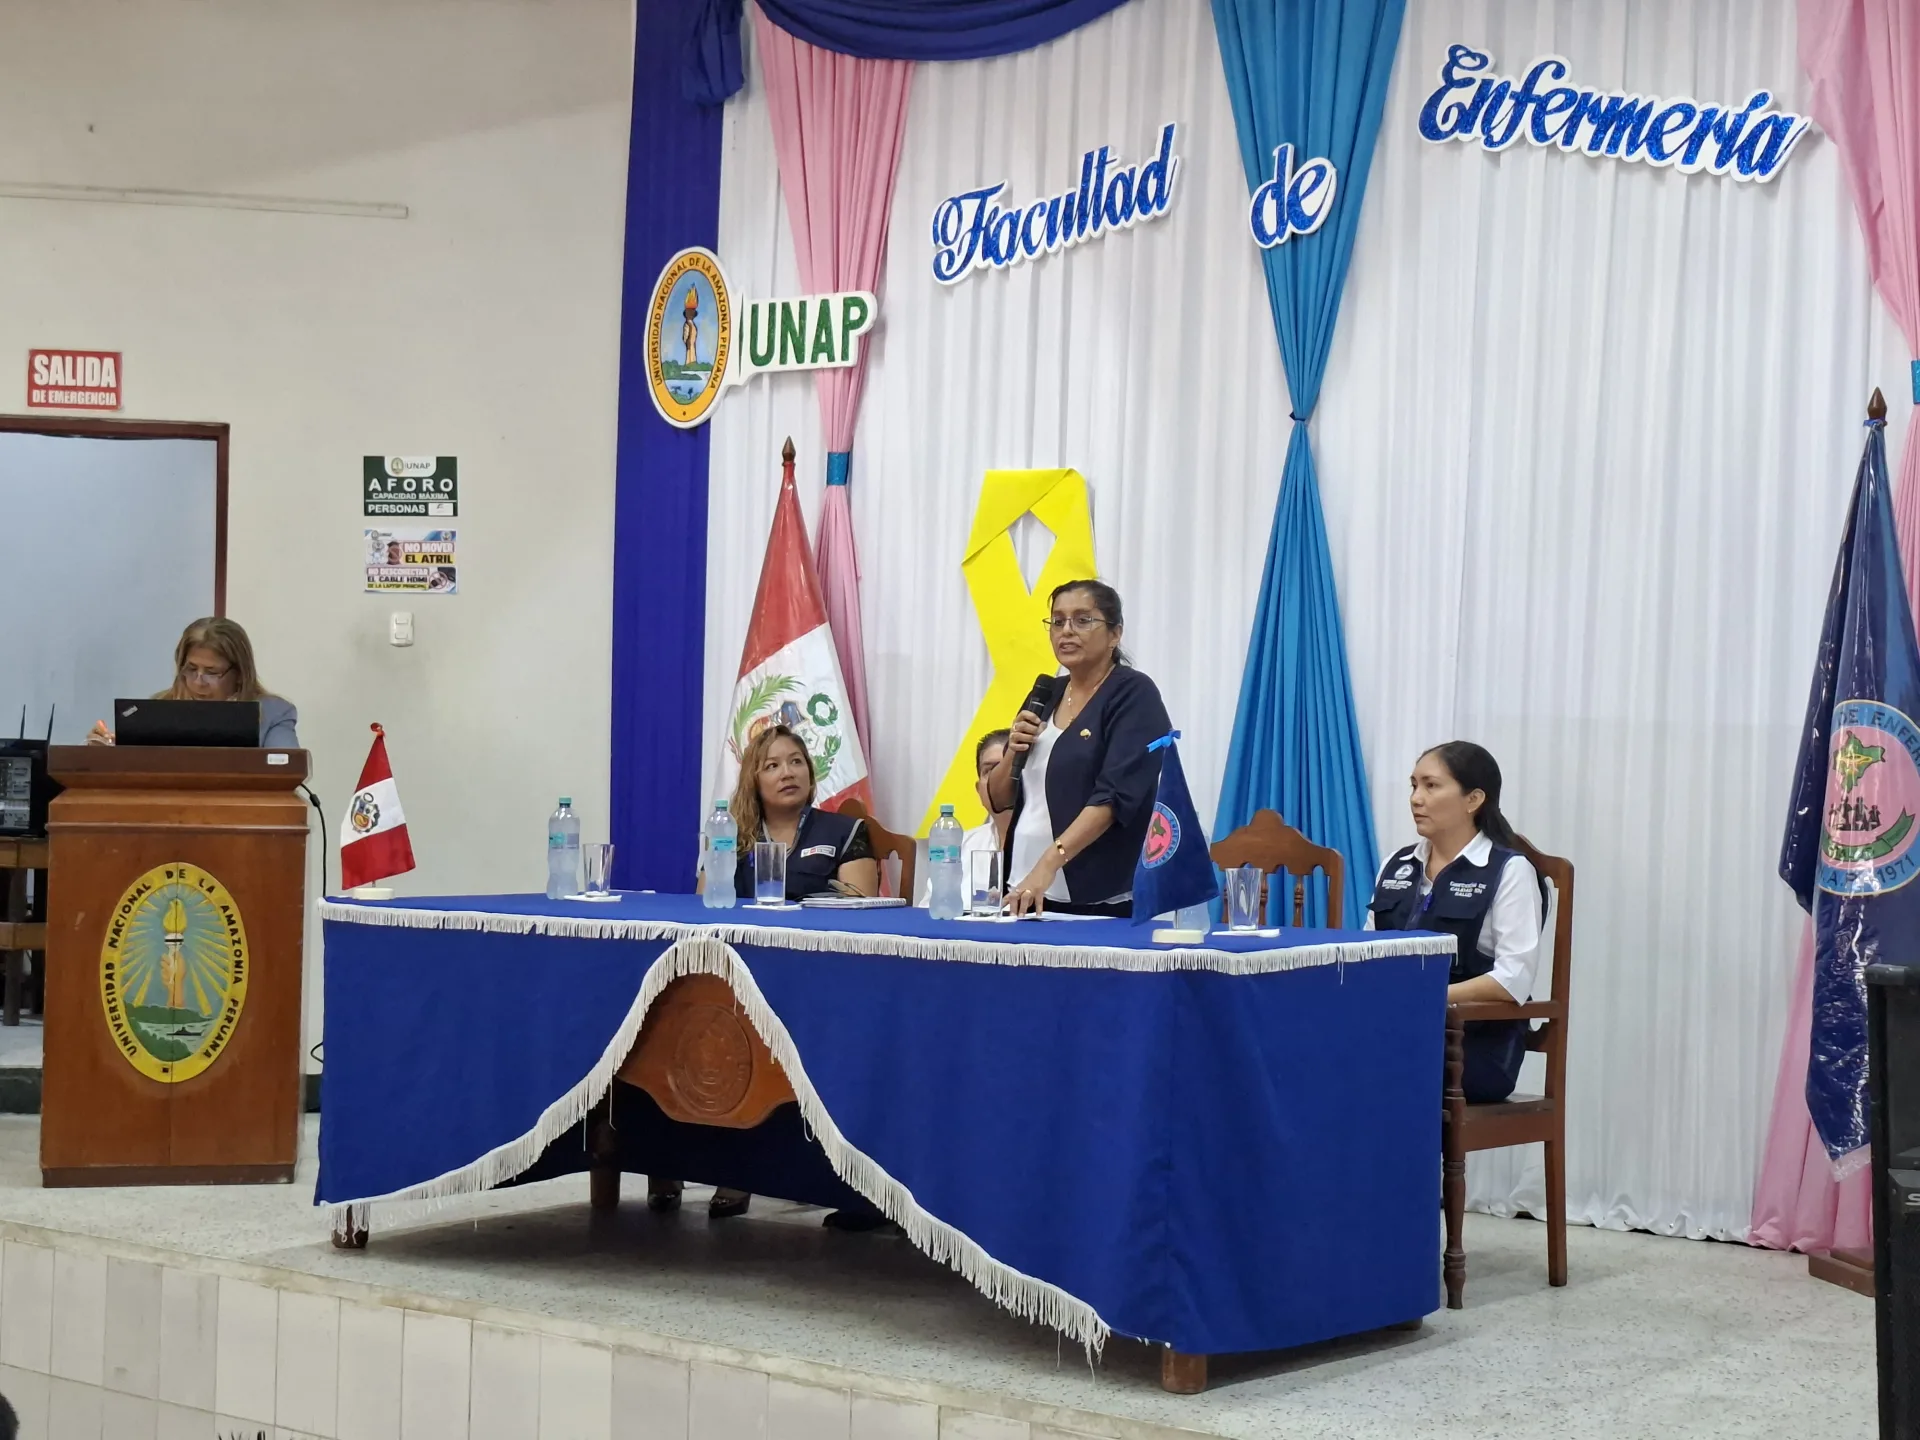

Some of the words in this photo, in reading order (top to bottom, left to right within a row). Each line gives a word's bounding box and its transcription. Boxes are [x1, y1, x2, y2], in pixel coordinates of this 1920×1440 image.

[933, 123, 1178, 281] Facultad
[1252, 143, 1334, 247] de
[1418, 44, 1811, 176] Enfermería
[651, 312, 663, 386] UNIVERSIDAD
[657, 261, 688, 311] NACIONAL
[689, 257, 701, 267] DE
[702, 260, 712, 274] LA
[710, 336, 728, 389] PERUANA
[750, 295, 869, 367] UNAP
[33, 353, 117, 388] SALIDA
[32, 389, 47, 403] DE
[48, 390, 117, 406] EMERGENCIA
[406, 462, 431, 470] UNAP
[368, 478, 454, 492] AFORO
[418, 491, 449, 500] MÁXIMA
[368, 504, 426, 513] PERSONAS
[404, 542, 420, 553] NO
[421, 542, 454, 553] MOVER
[405, 554, 418, 564] EL
[421, 554, 453, 564] ATRIL
[165, 868, 186, 879] DE
[1876, 853, 1915, 884] 1971
[198, 878, 216, 895] LA
[108, 882, 151, 949] NACIONAL
[220, 903, 244, 985] AMAZONIA
[105, 962, 138, 1058] UNIVERSIDAD
[202, 998, 239, 1059] PERUANA
